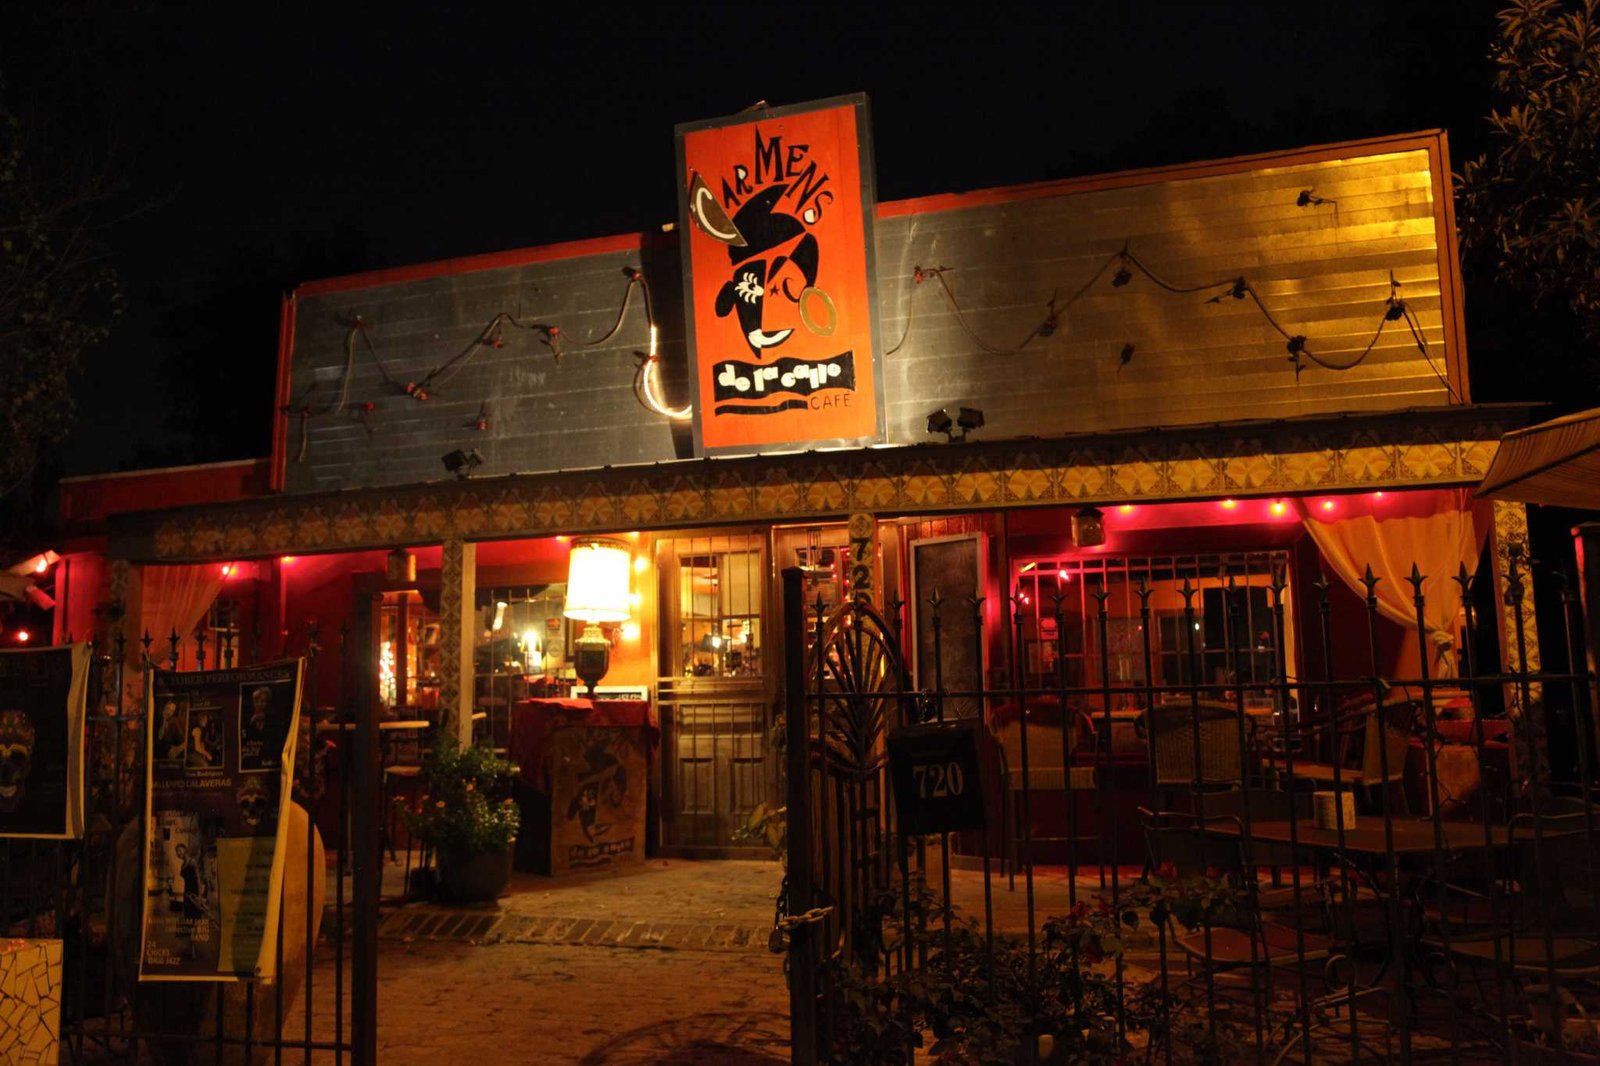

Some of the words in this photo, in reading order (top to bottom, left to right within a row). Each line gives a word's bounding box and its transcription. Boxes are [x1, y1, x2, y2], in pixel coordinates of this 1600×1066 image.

[718, 363, 752, 392] de
[753, 366, 779, 392] la
[781, 363, 841, 389] calle
[912, 761, 964, 799] 720
